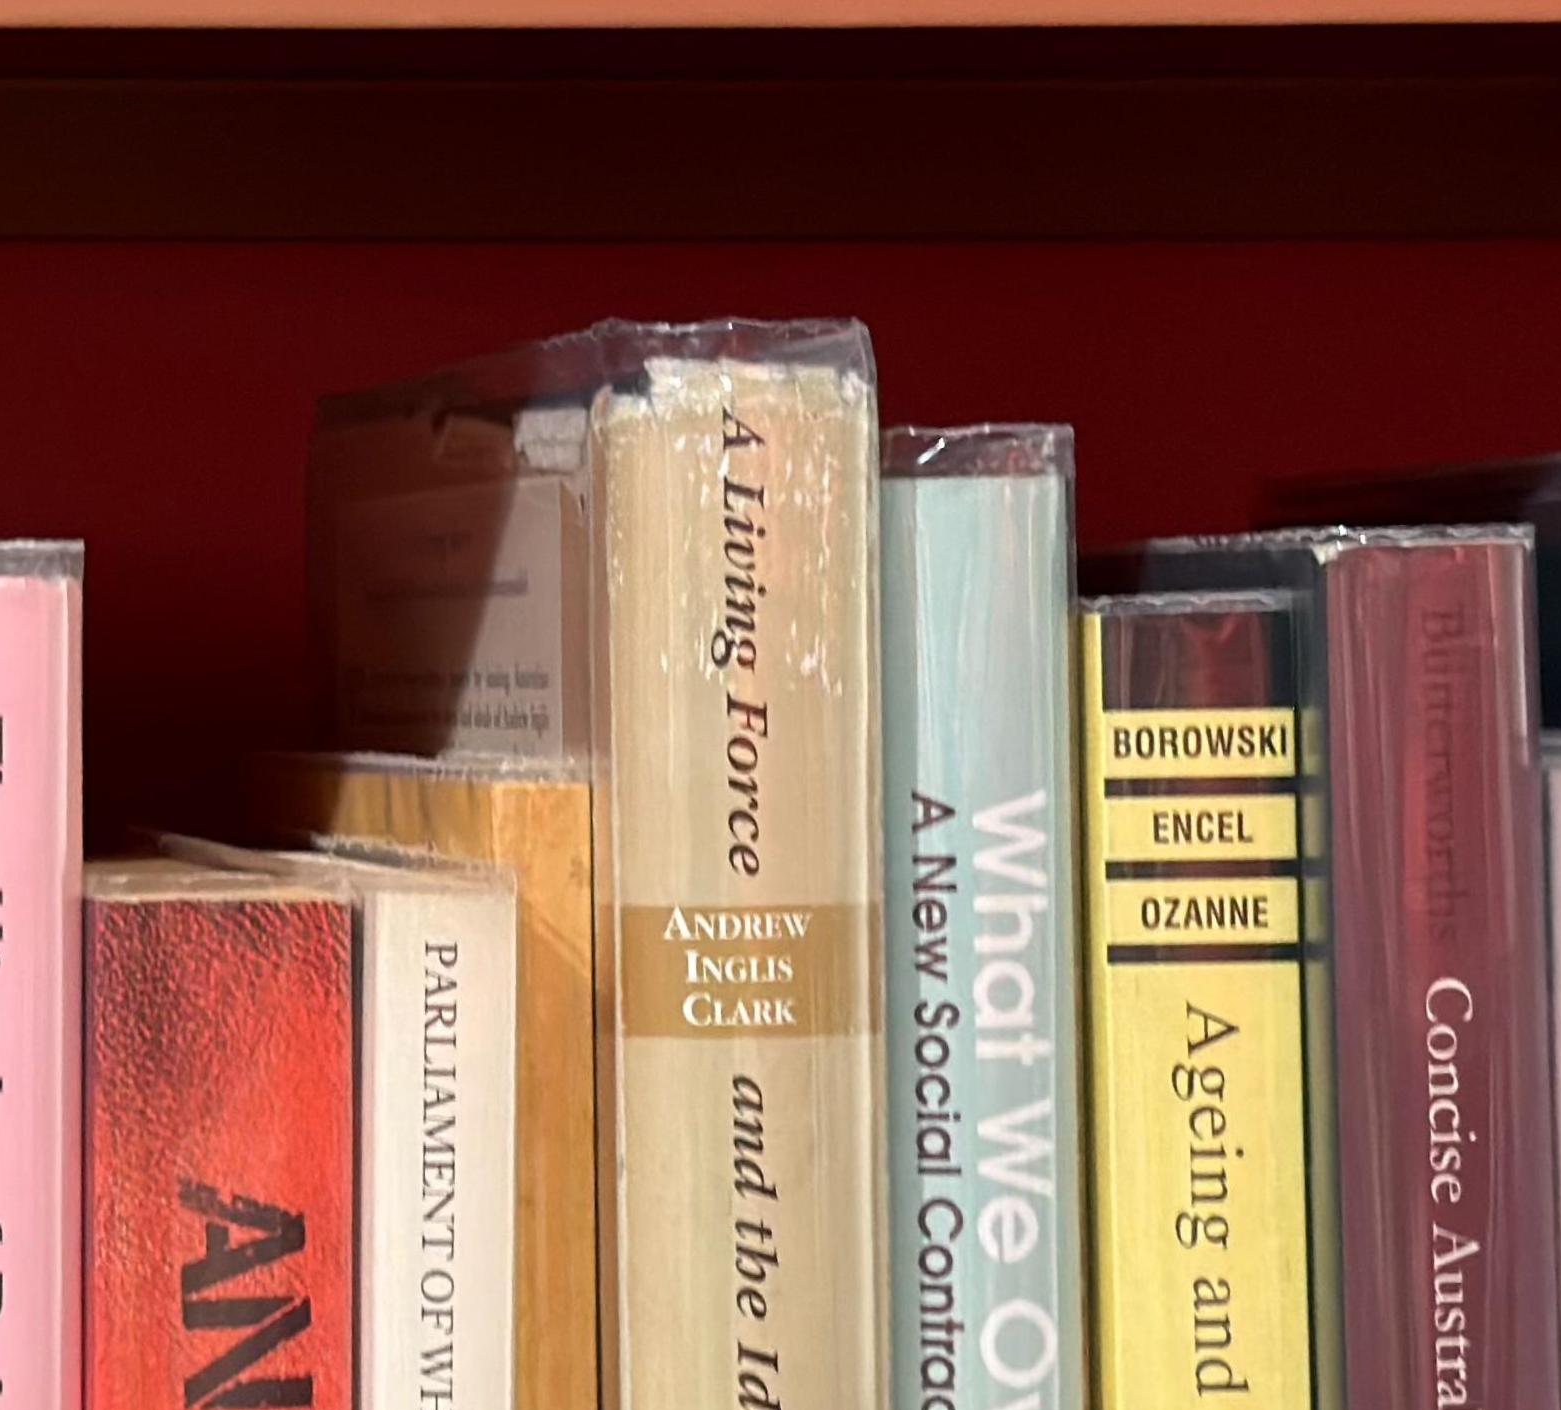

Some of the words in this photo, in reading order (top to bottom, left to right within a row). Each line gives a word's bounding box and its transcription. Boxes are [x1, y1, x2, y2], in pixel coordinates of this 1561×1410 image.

[711, 476, 765, 672] Living
[726, 692, 767, 877] Force
[1114, 726, 1288, 760] BOROWSKI
[1154, 813, 1253, 844] ENCEL
[663, 907, 813, 942] ANDREW
[686, 953, 793, 984] INGLIS
[912, 856, 957, 983] New
[973, 790, 1051, 1066] What
[1141, 897, 1269, 931] OZANNE
[682, 992, 796, 1027] CLARK
[422, 941, 458, 1261] PARLIAMENT
[914, 1001, 961, 1175] Social
[1173, 1003, 1244, 1252] Ageing
[1426, 977, 1477, 1203] Concise
[420, 1269, 455, 1336] OF
